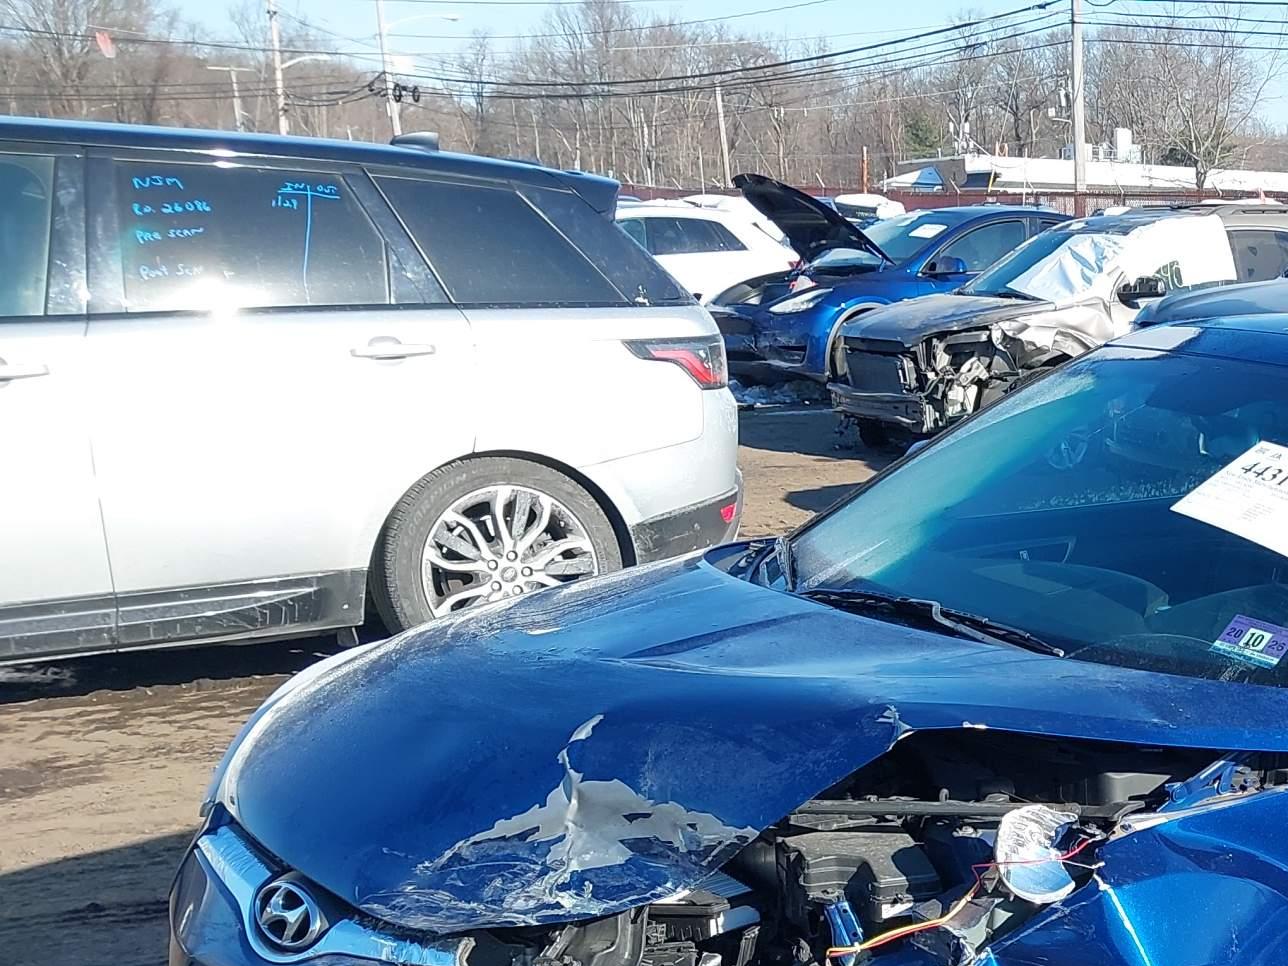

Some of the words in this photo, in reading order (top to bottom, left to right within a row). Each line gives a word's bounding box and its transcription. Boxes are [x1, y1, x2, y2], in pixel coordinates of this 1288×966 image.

[279, 182, 305, 191] IN
[1226, 626, 1244, 639] 20
[1244, 631, 1265, 649] 10
